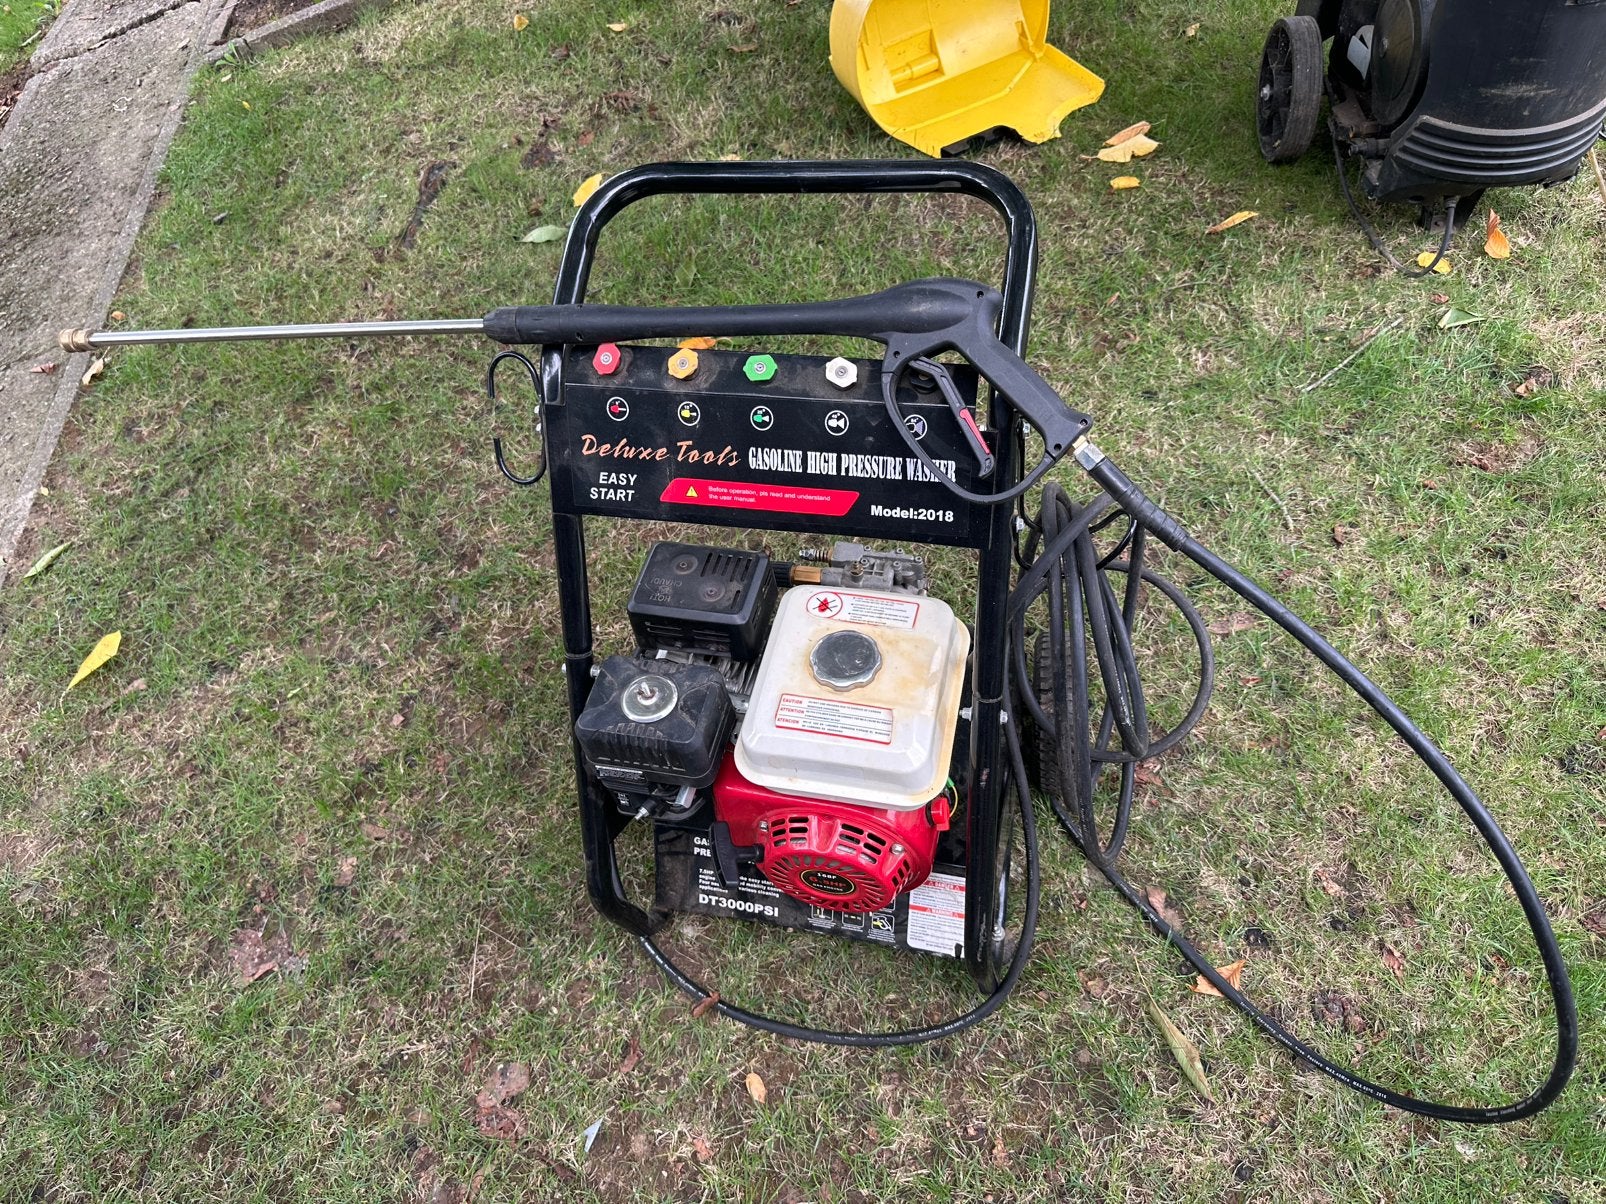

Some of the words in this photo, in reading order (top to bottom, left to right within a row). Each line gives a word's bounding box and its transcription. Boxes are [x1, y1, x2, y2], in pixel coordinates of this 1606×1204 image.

[581, 434, 670, 461] Deluxe
[677, 440, 742, 467] Tools
[748, 446, 803, 473] GASOLINE
[807, 451, 837, 475] HIGH
[841, 453, 903, 480] PRESSURE
[599, 471, 637, 486] EASY
[589, 487, 635, 502] START
[708, 485, 728, 493] Before
[729, 488, 758, 497] operation,
[797, 493, 831, 502] understand
[870, 505, 954, 522] Model:2018
[782, 697, 803, 705] CAUTION
[780, 706, 805, 714] ATTENTION
[698, 893, 779, 917] DT3000PSI
